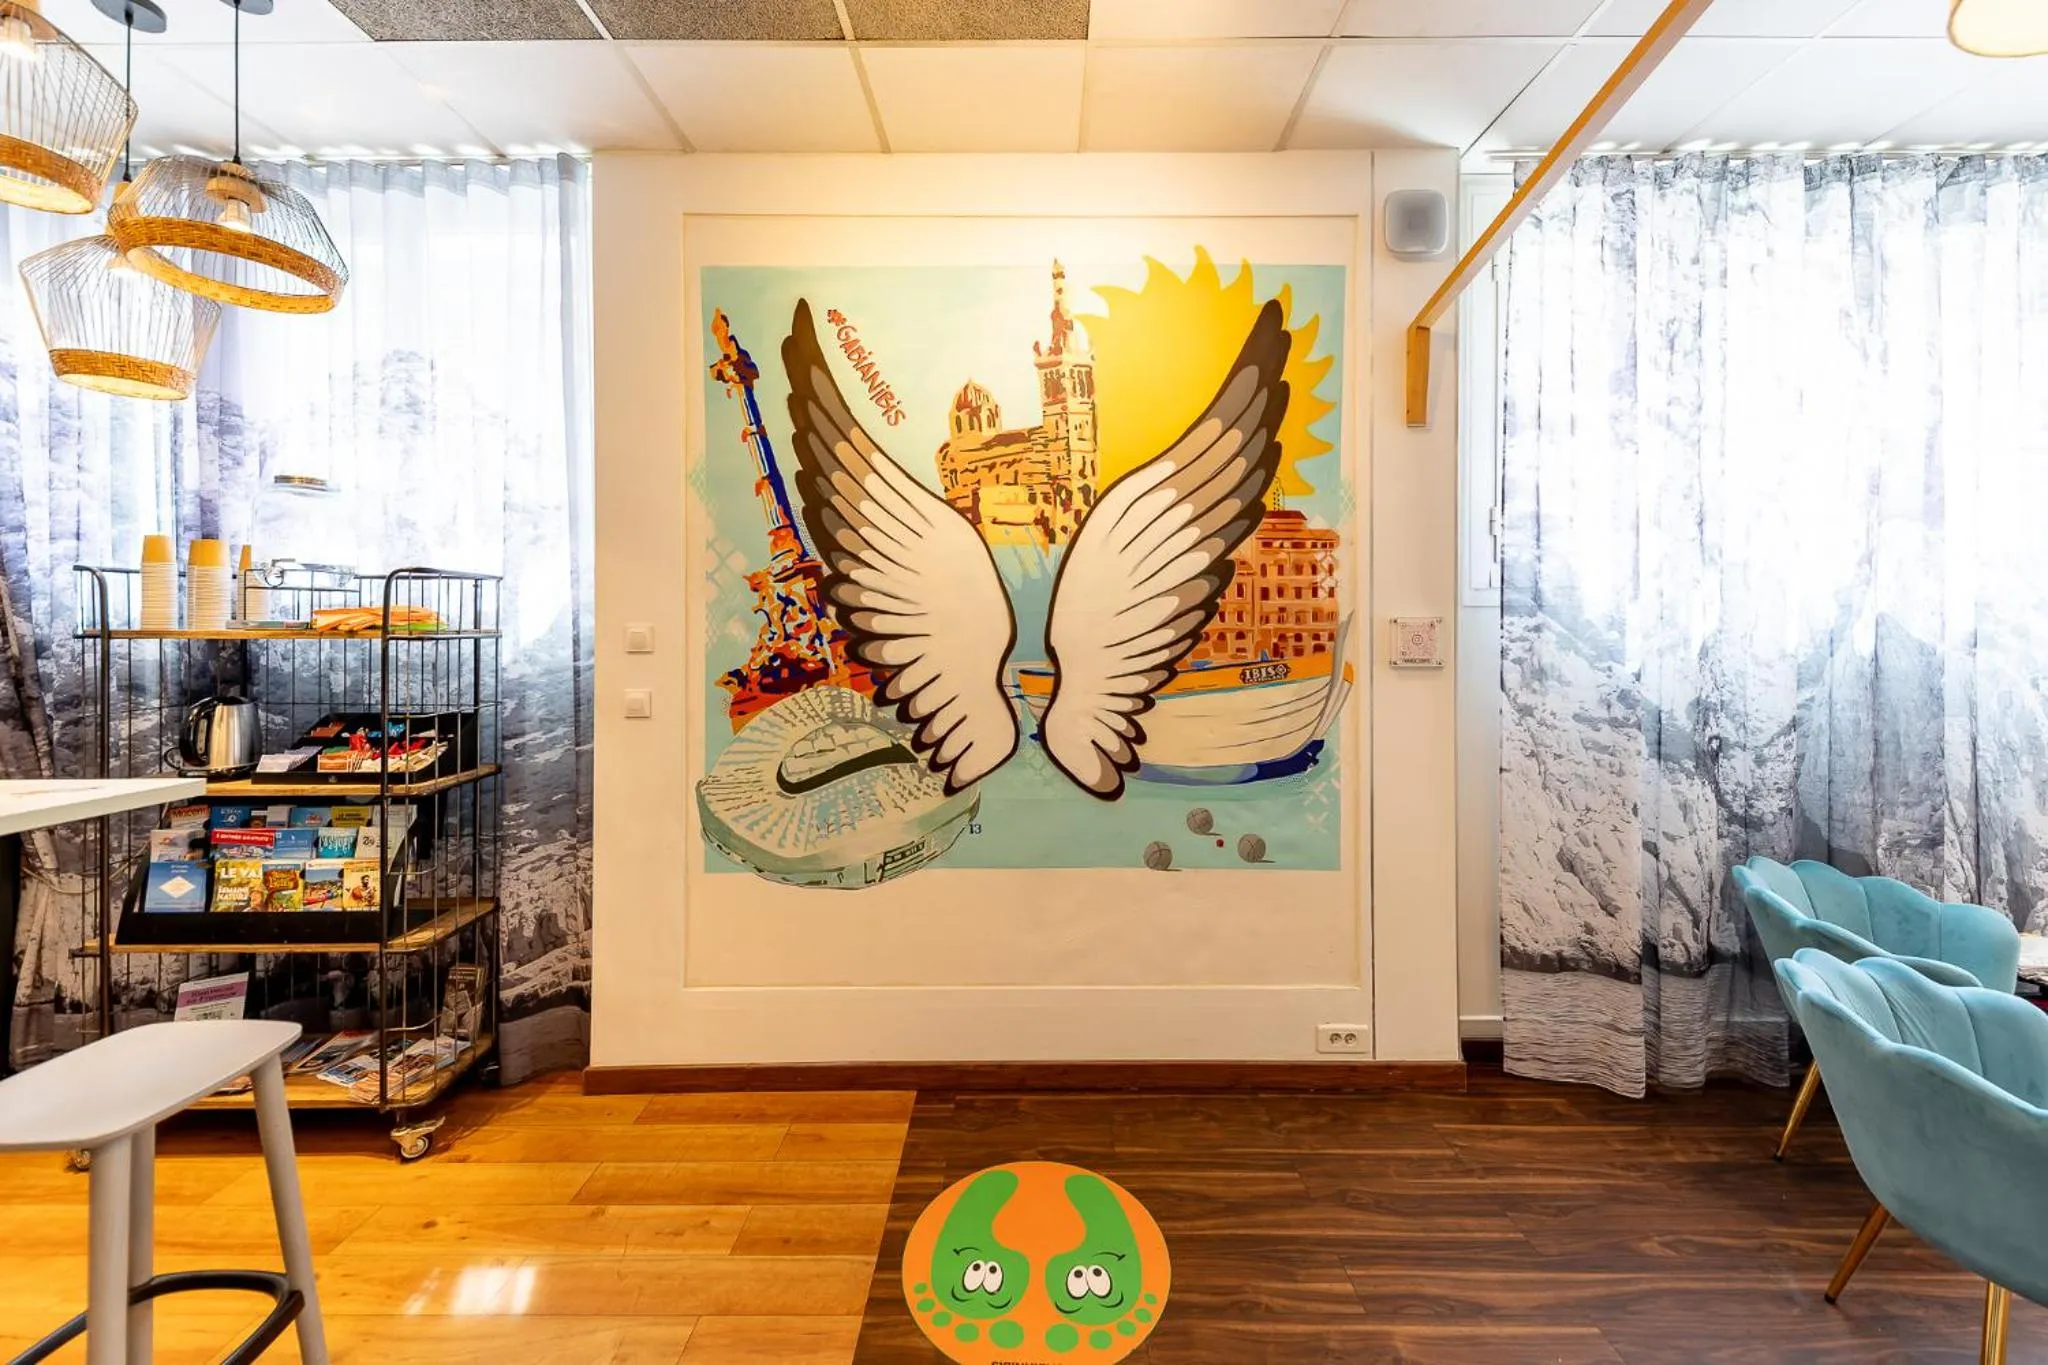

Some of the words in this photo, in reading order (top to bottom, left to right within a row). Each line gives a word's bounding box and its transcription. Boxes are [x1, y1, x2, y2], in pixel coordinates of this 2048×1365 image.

[1245, 666, 1275, 679] IBIS
[970, 823, 982, 834] 13
[220, 867, 237, 879] LE
[241, 867, 262, 879] VA
